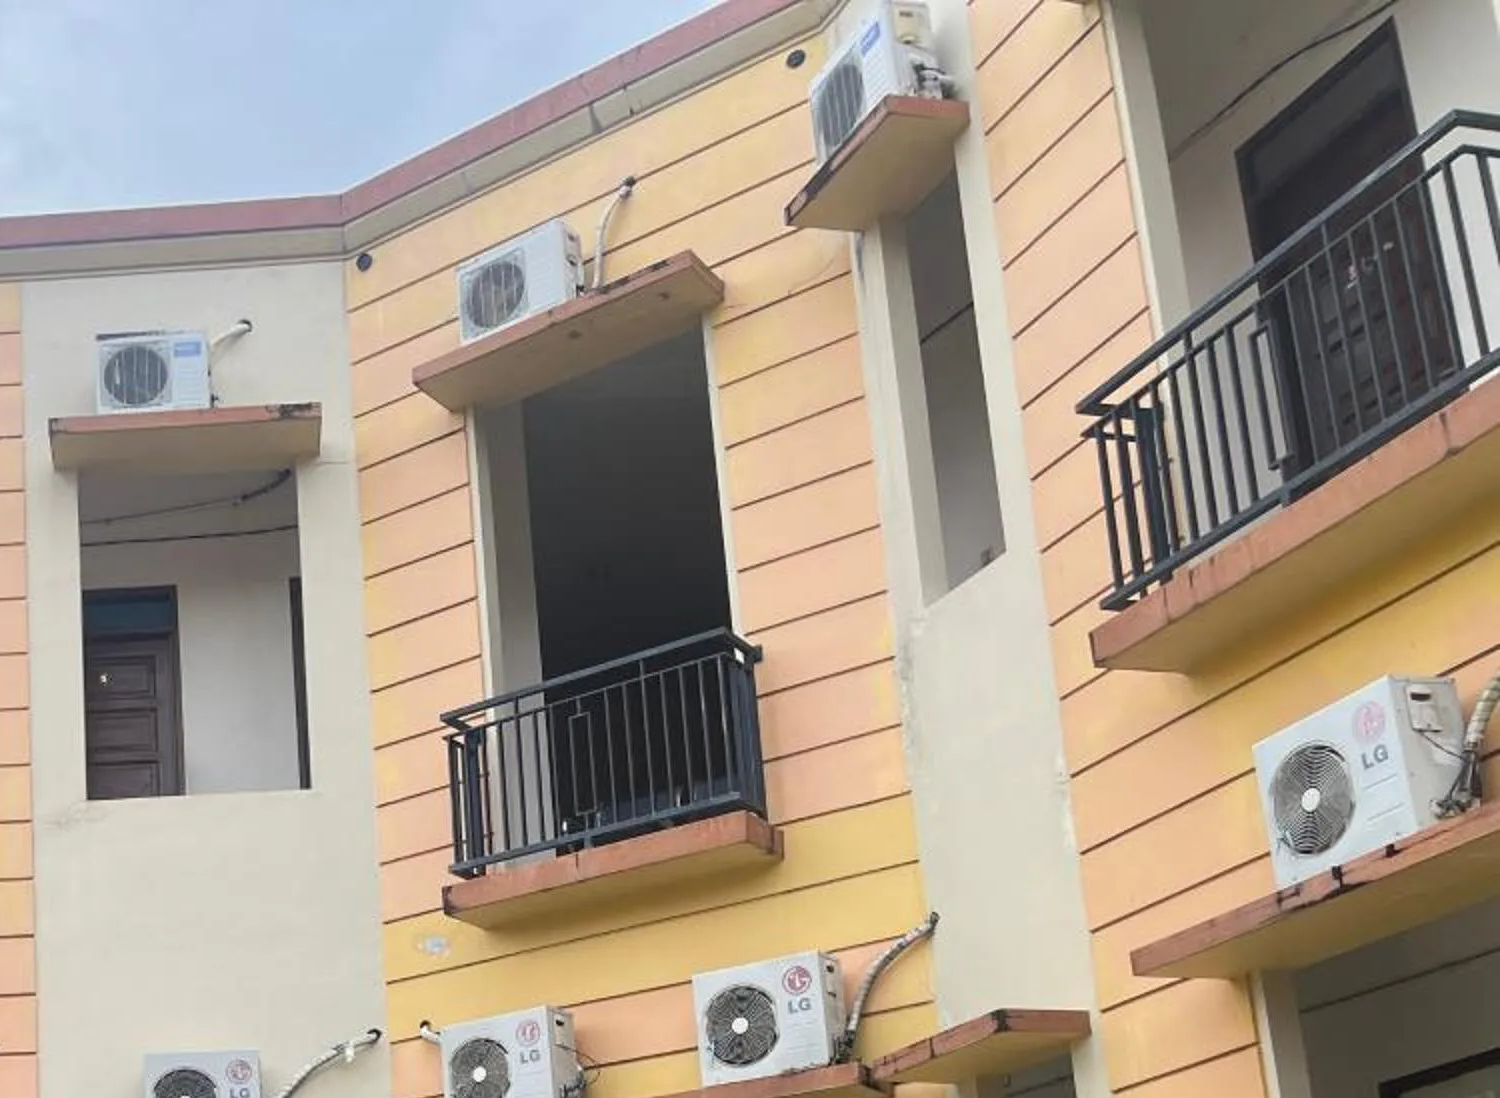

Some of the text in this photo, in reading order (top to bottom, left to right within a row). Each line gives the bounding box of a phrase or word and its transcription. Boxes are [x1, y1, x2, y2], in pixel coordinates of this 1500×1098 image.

[1361, 744, 1389, 771] LG
[787, 997, 812, 1014] LG
[520, 1049, 541, 1065] LG
